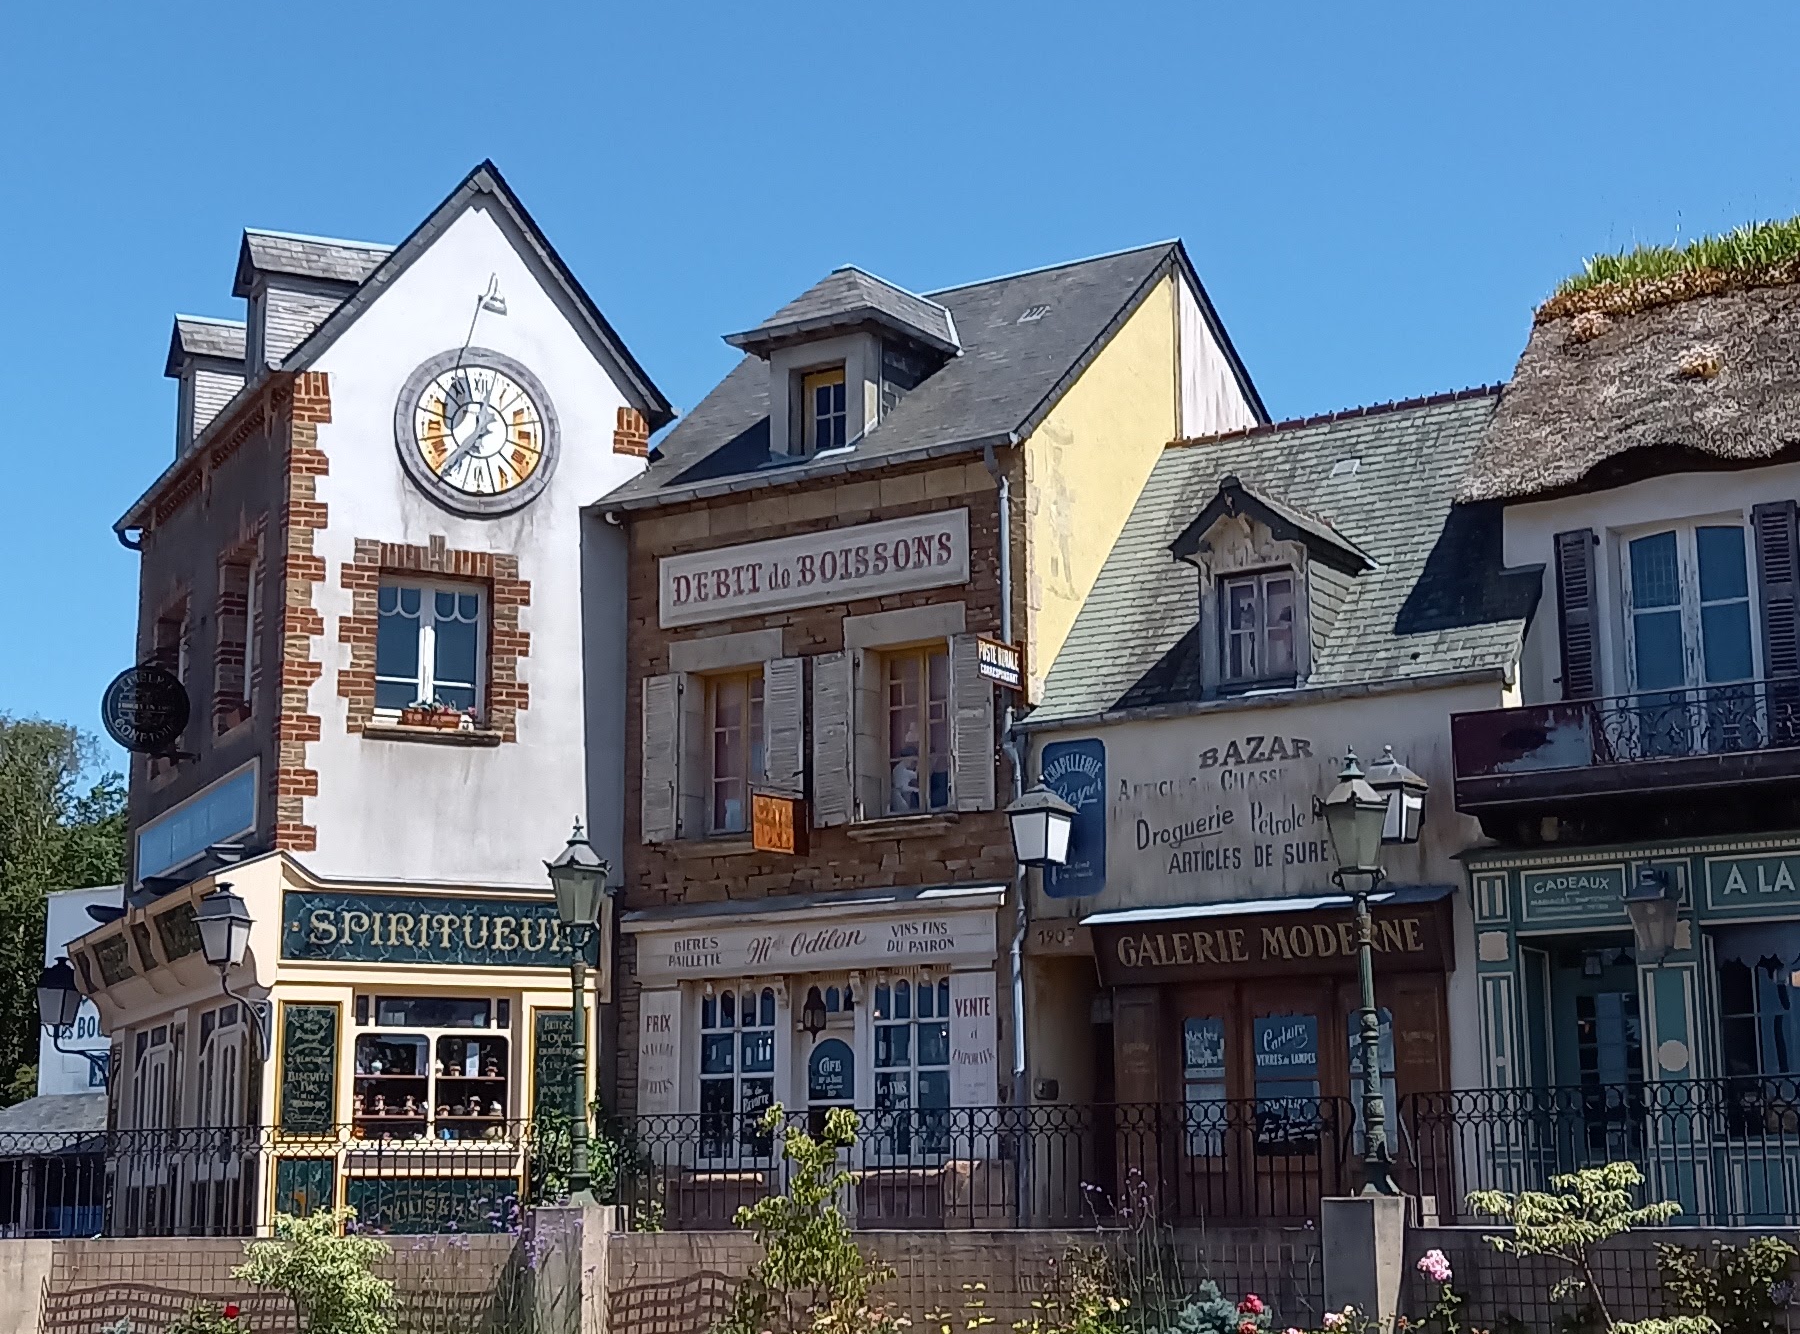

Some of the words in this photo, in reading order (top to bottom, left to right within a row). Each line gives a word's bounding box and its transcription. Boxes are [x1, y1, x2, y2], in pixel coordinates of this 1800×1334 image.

[796, 532, 952, 585] BOISSONS
[1199, 736, 1313, 769] BAZAR
[1043, 753, 1103, 783] CHAPELLERIE
[1137, 805, 1234, 850] Droguerie
[1168, 845, 1241, 874] ARTICLES
[1254, 844, 1273, 868] DE
[1284, 840, 1335, 865] SURE
[1533, 877, 1609, 893] CADEAUX
[1723, 863, 1747, 894] A
[1757, 861, 1795, 893] LA
[790, 927, 866, 958] Odilon
[891, 922, 919, 937] VINS
[922, 921, 948, 936] FINS
[1118, 928, 1249, 967] GALERIE
[1262, 918, 1424, 961] MODERNE
[668, 952, 722, 967] PAILLETTE
[886, 938, 904, 953] DU
[909, 936, 955, 953] PATRON
[955, 997, 990, 1018] VENTE
[646, 1014, 671, 1033] PRIX
